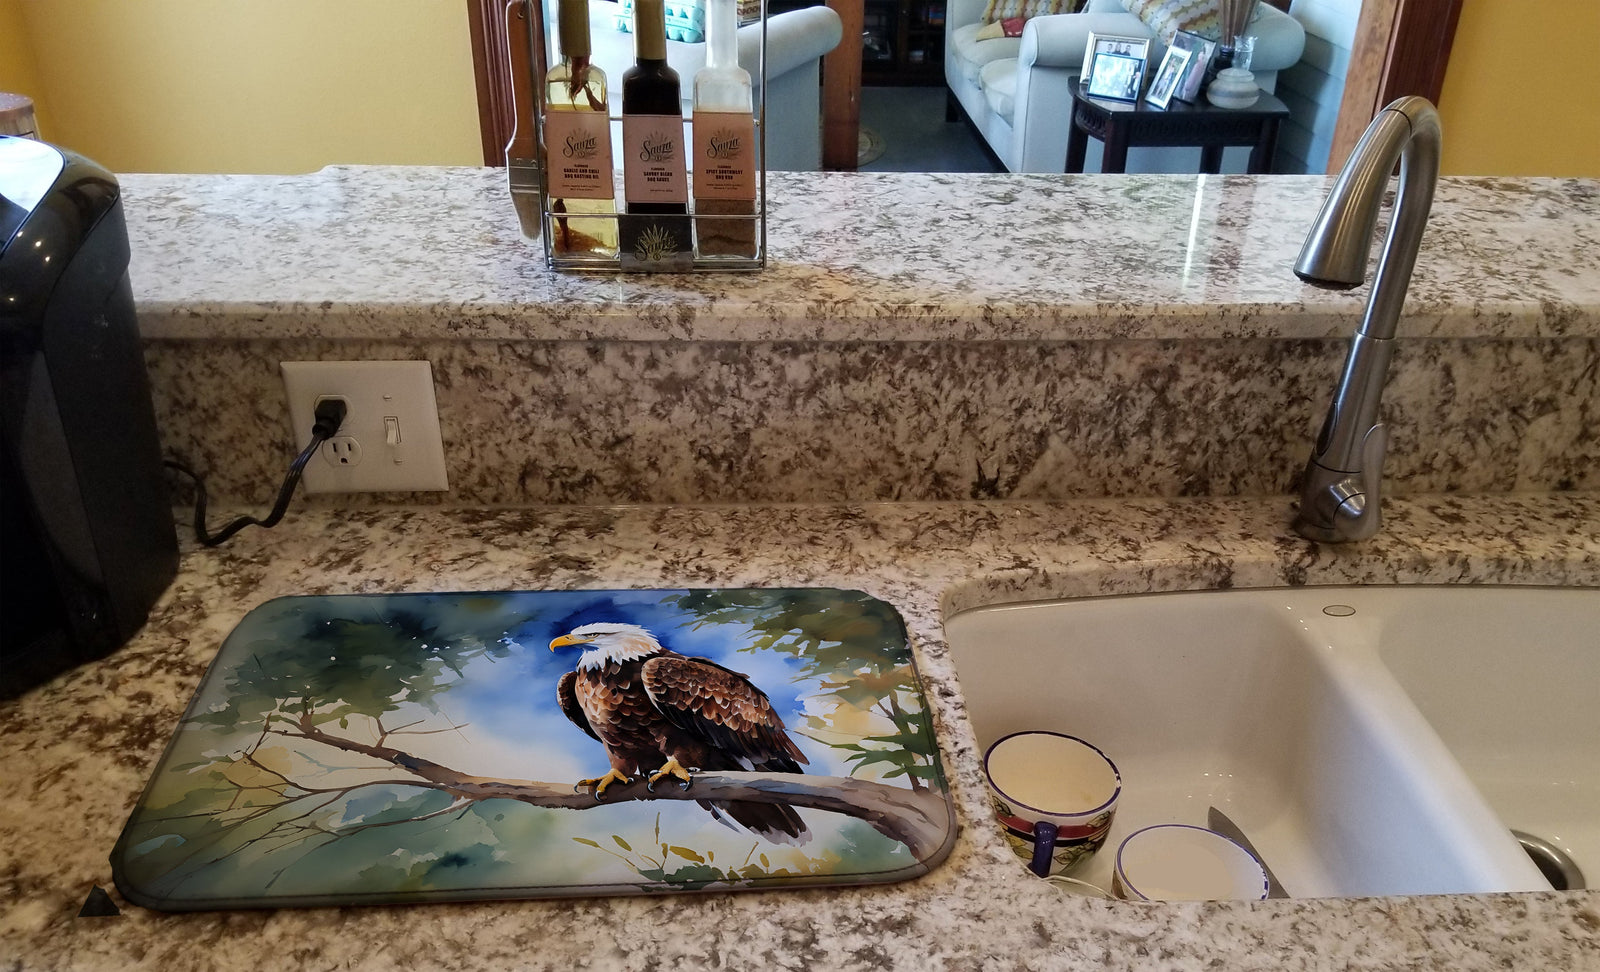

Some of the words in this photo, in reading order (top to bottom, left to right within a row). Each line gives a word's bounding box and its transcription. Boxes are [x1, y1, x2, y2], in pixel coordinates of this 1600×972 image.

[563, 136, 597, 158] Sauza
[640, 140, 673, 162] Sauza
[707, 136, 740, 159] Sauza
